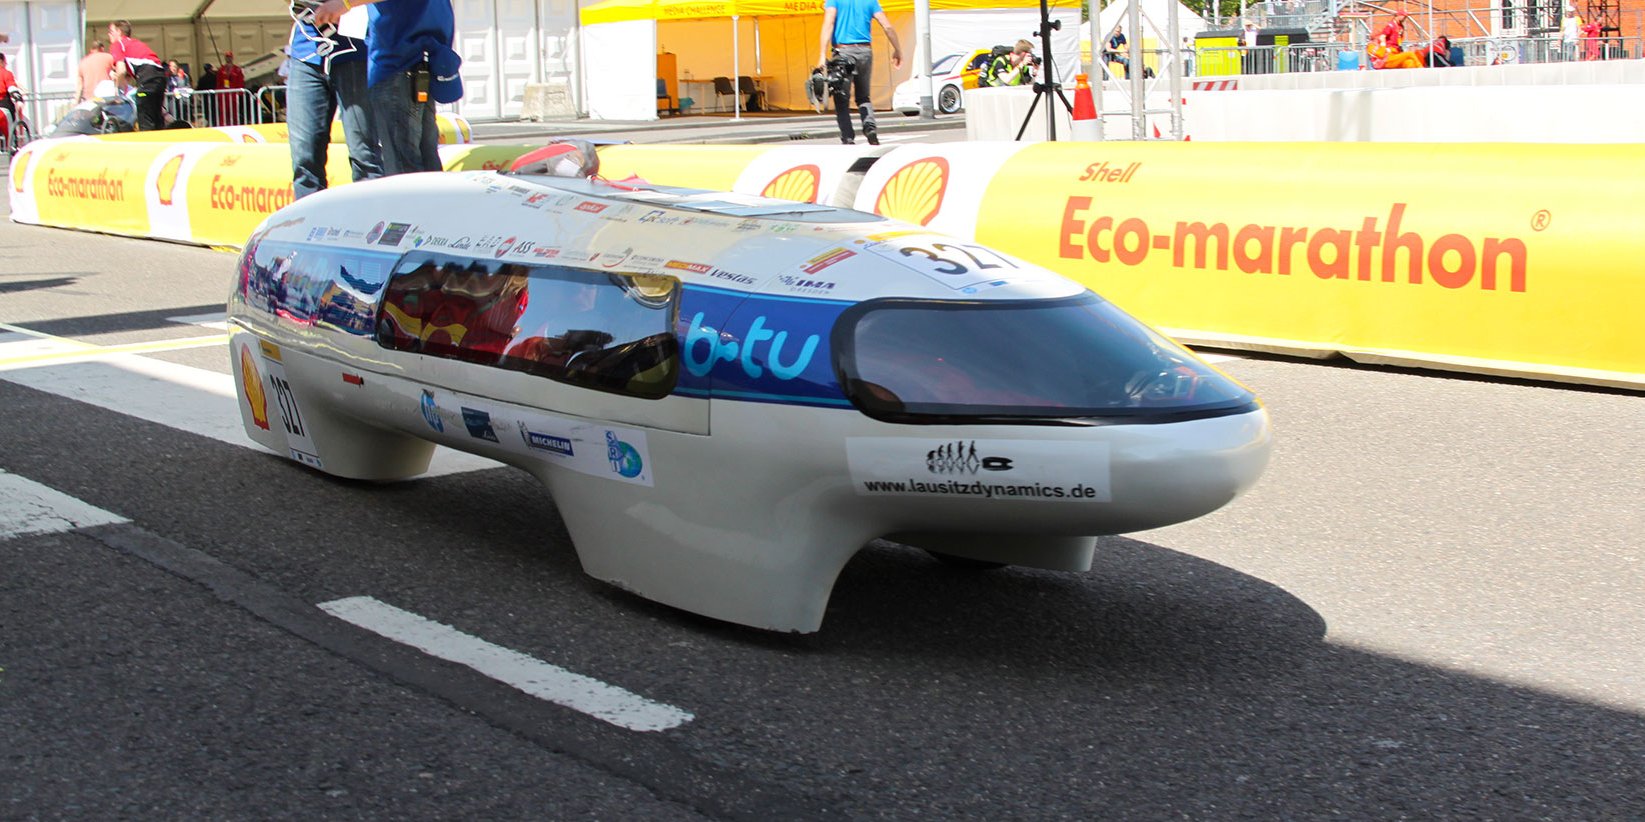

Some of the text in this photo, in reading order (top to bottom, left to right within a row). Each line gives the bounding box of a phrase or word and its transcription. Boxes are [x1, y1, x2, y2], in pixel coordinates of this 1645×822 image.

[664, 4, 726, 16] MEDIA CHALLENGE
[784, 1, 817, 12] MEDIA
[1079, 161, 1142, 184] Shell
[48, 167, 125, 202] Eco-marathon
[1058, 195, 1528, 293] Eco-marathon
[899, 242, 1020, 275] 327
[710, 268, 758, 285] Vestas
[795, 278, 837, 290] IMA
[269, 374, 305, 437] 327
[531, 434, 572, 452] MICHELIN
[864, 478, 1096, 499] www.lausitzdynamics.de
